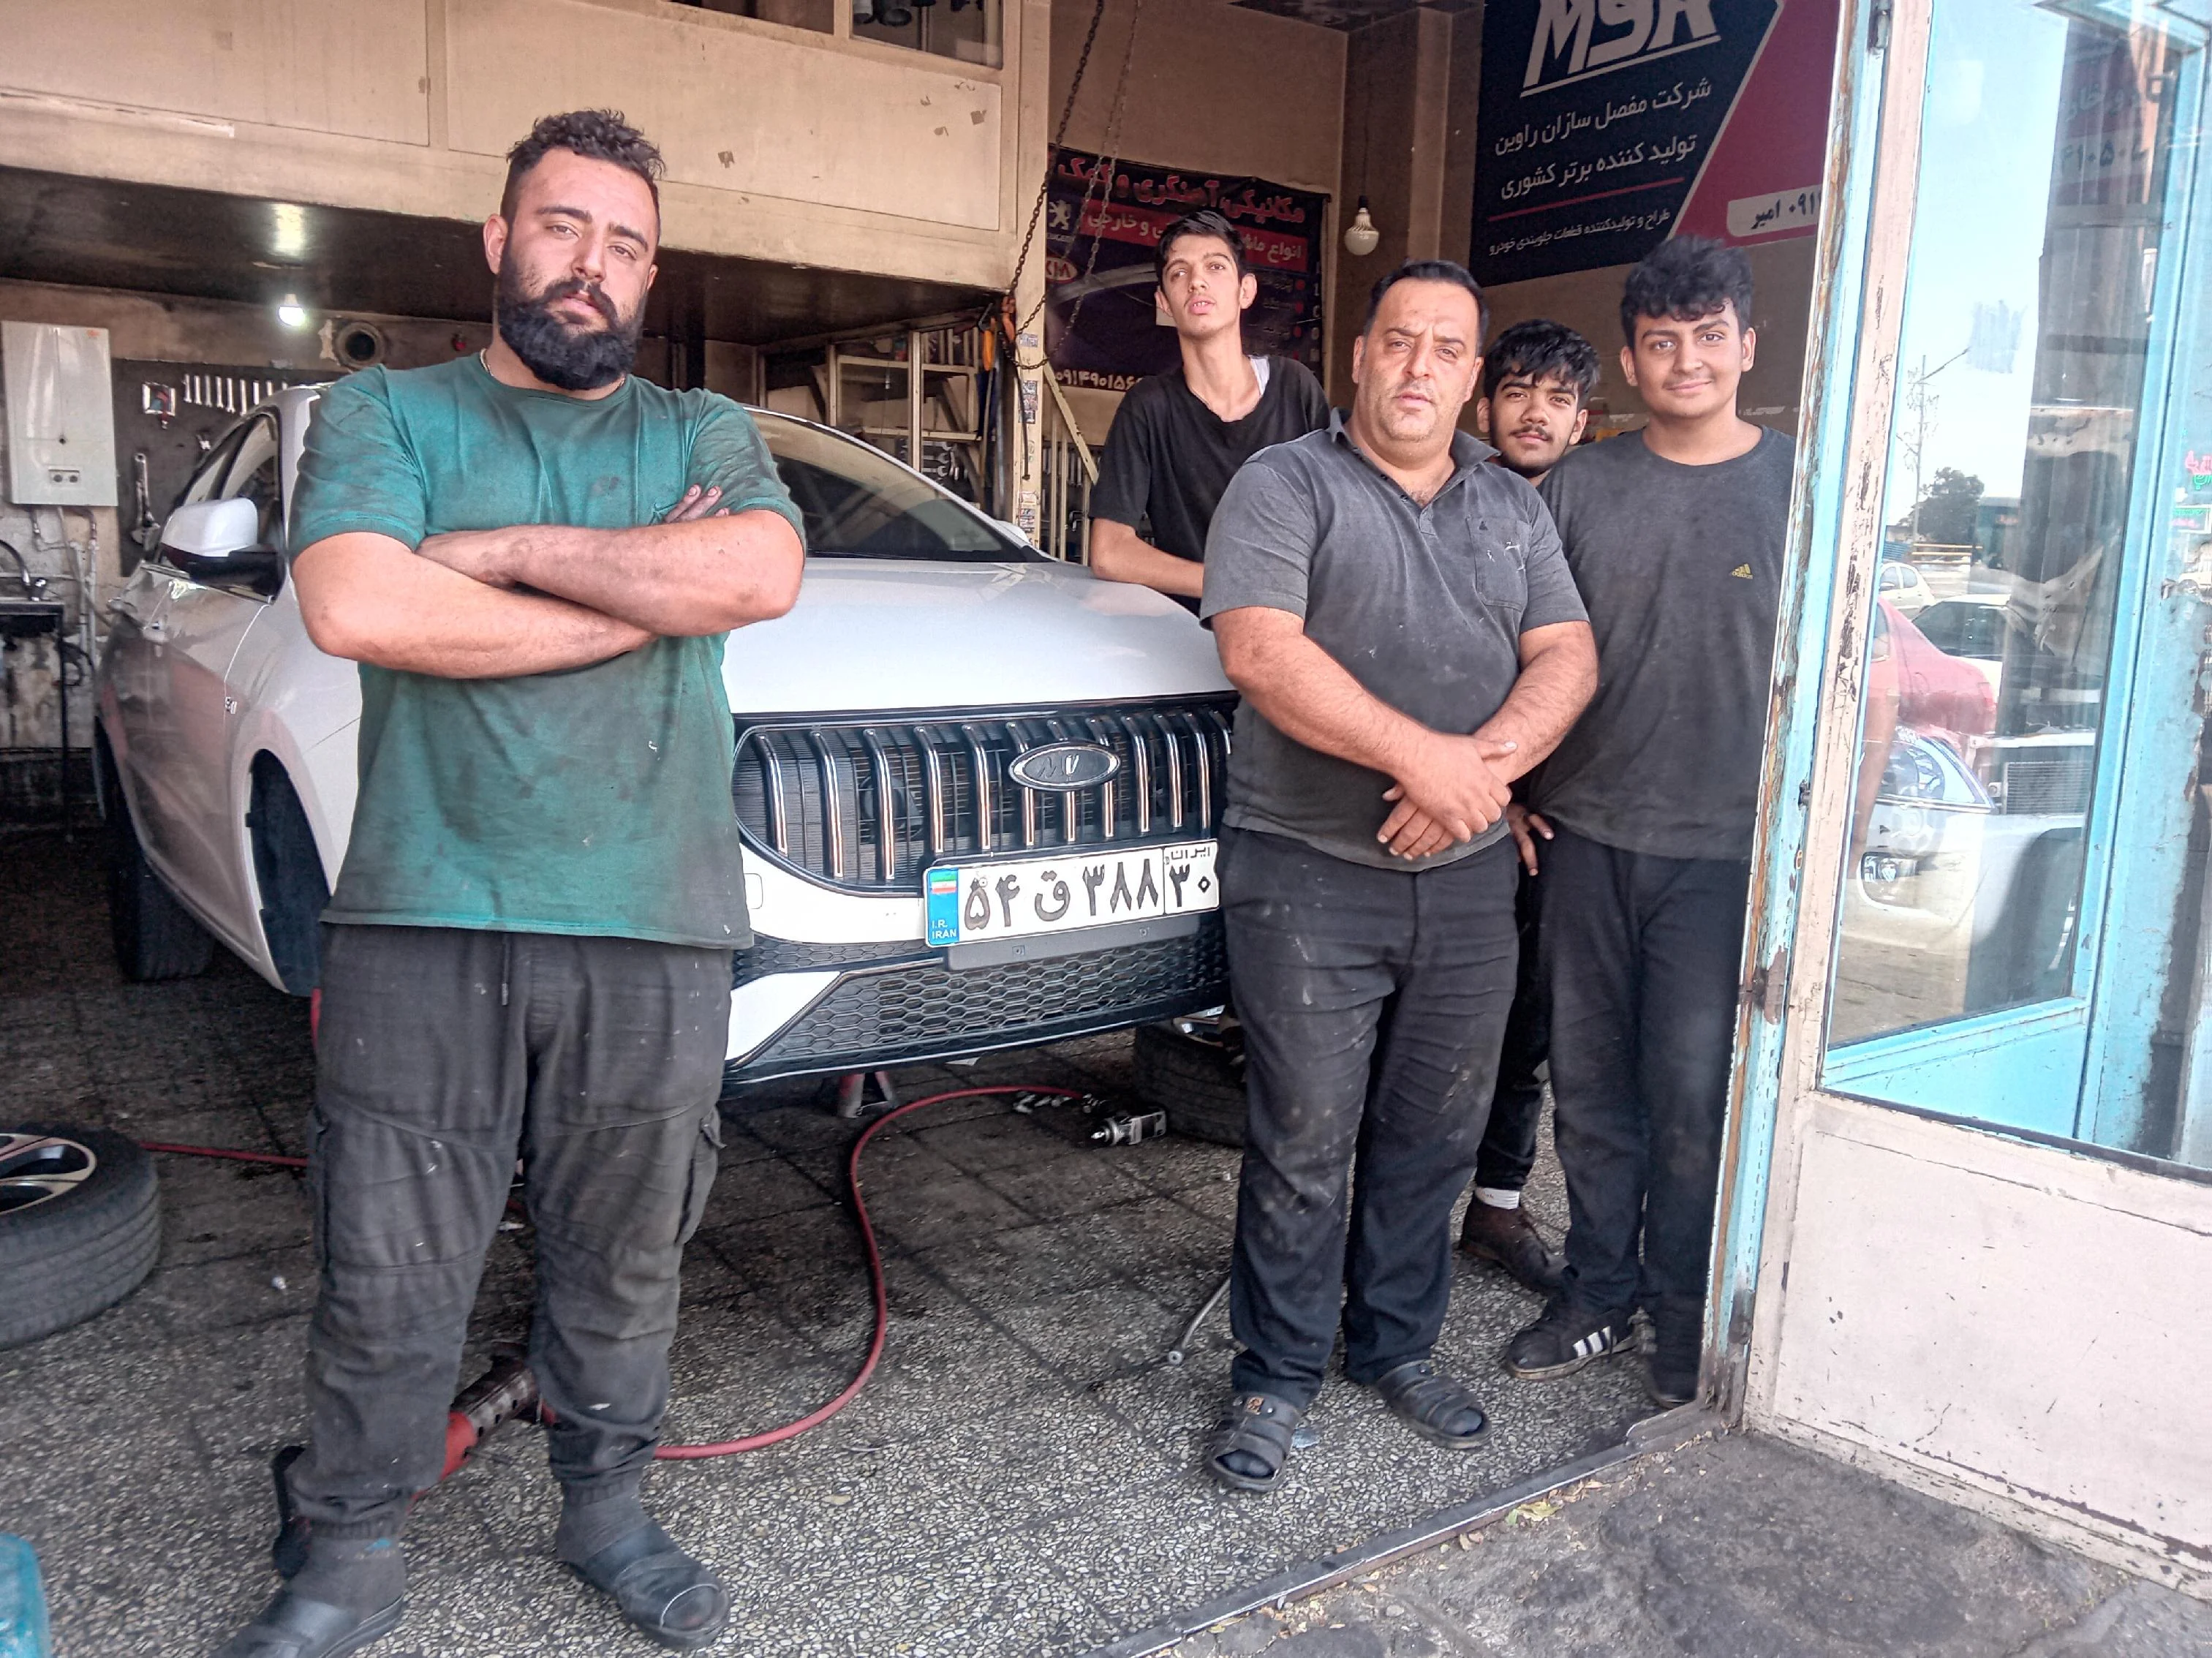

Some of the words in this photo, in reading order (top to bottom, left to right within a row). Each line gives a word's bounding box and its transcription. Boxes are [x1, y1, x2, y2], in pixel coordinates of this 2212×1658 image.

[1653, 77, 1711, 109] شرکت
[1595, 95, 1647, 129] مفصل
[1495, 124, 1538, 156] راوین
[1541, 111, 1591, 143] سازان
[1596, 142, 1645, 171] کننده
[1648, 135, 1697, 164] تولید
[1501, 163, 1555, 200] کشوری
[1558, 162, 1592, 187] برتر
[1636, 216, 1644, 229] و
[1646, 208, 1670, 230] طراح
[1751, 199, 1781, 230] امیر
[1140, 222, 1149, 236] و
[1554, 225, 1582, 241] قطعات
[1267, 242, 1302, 263] انواع
[1489, 238, 1516, 256] خودرو
[1171, 846, 1210, 862] ایران
[1034, 870, 1071, 922] ق
[1169, 863, 1211, 908] ۳۰
[932, 919, 948, 929] I.R.
[932, 929, 956, 940] IRAN
